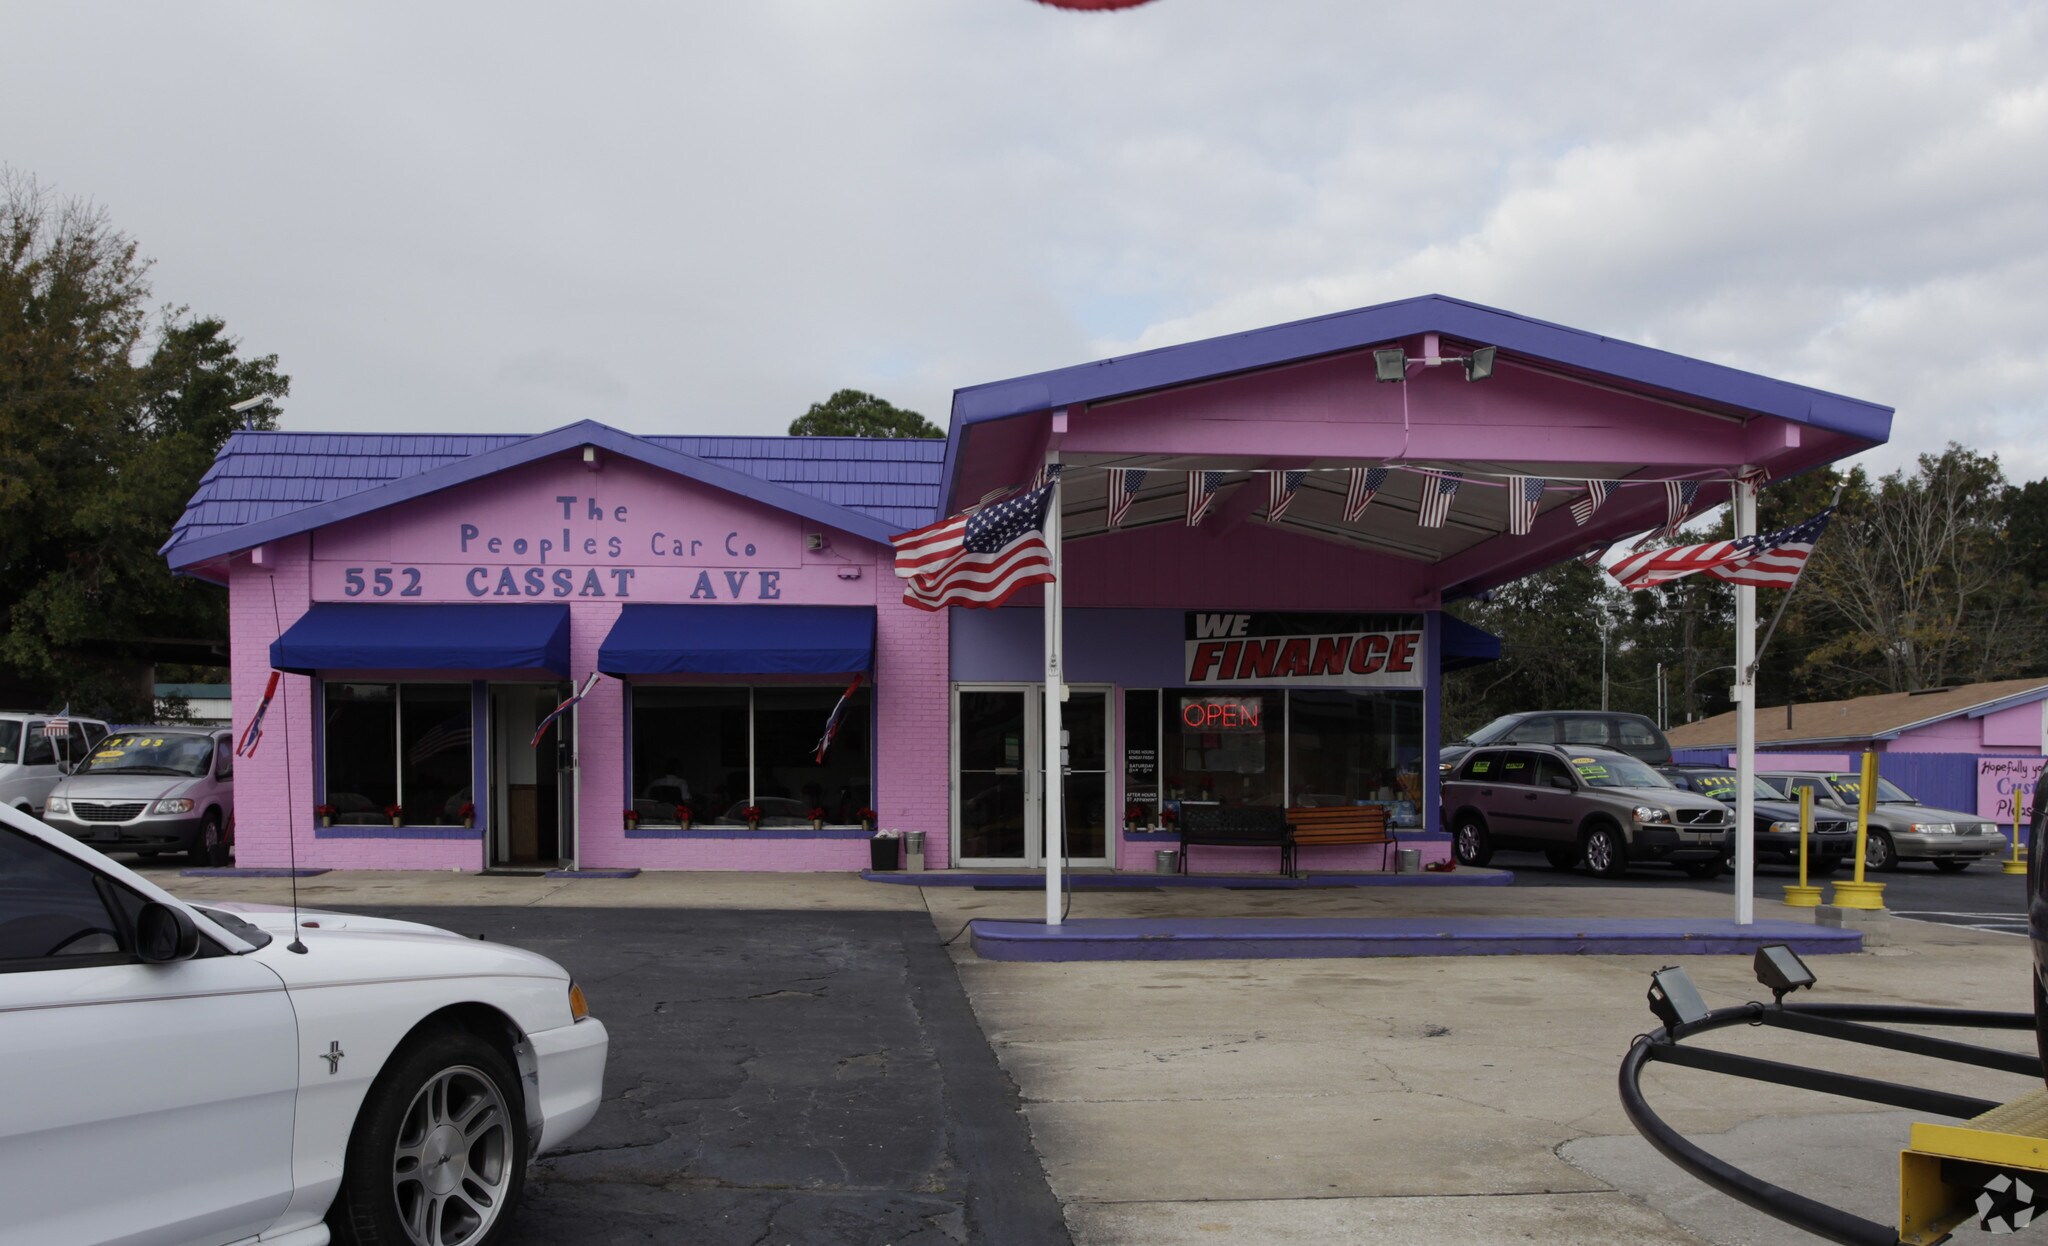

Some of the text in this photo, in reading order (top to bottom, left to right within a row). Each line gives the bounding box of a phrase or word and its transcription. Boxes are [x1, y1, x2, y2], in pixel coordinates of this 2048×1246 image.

[556, 496, 628, 522] The
[461, 523, 757, 564] Peoples Car Co
[345, 566, 781, 600] 552 CASSAT AVE
[1196, 614, 1251, 639] WE
[1189, 633, 1420, 681] FINANCE
[1183, 703, 1258, 727] OPEN
[1981, 760, 2043, 780] Hopefully yo
[1996, 777, 2038, 796] Cust
